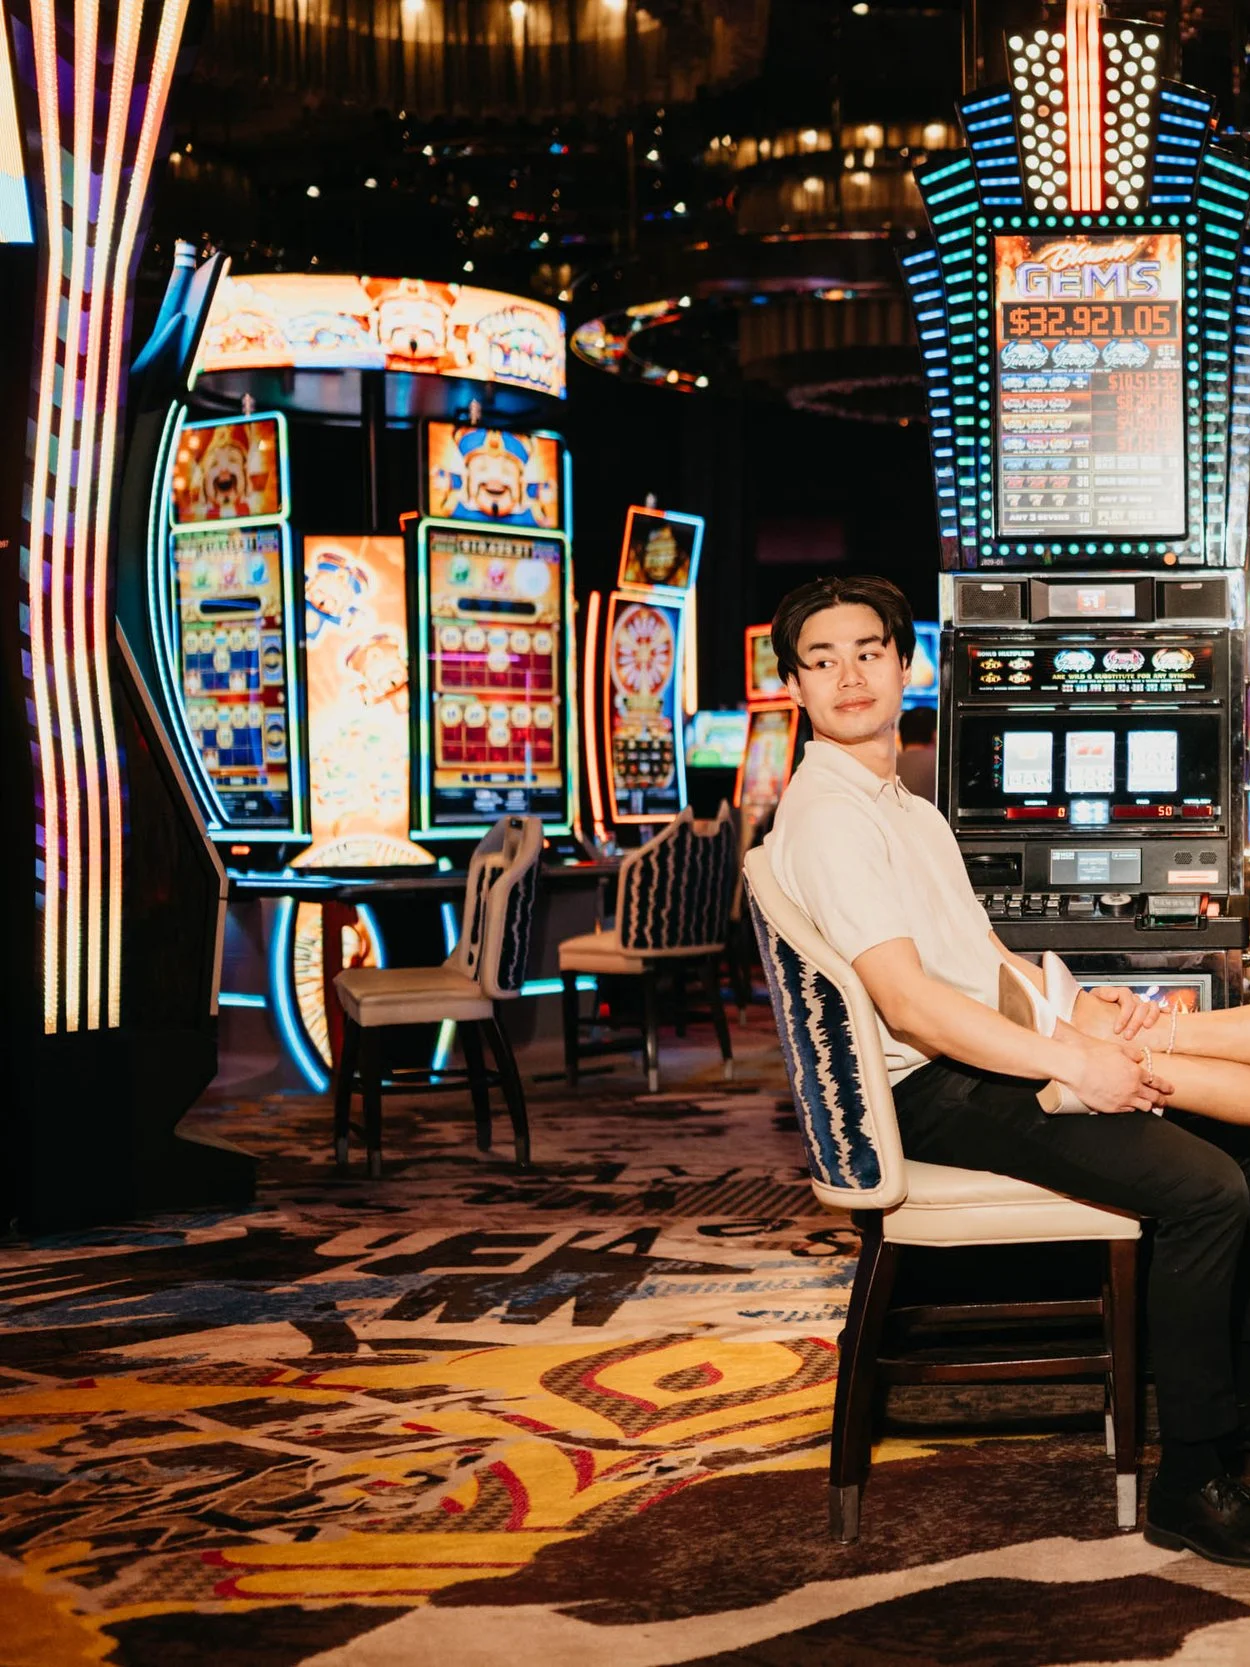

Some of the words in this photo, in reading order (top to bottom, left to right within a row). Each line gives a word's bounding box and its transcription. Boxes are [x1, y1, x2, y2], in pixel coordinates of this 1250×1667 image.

[1016, 261, 1161, 299] GEMS
[1009, 306, 1171, 336] $32,921.05
[1158, 806, 1173, 817] 50
